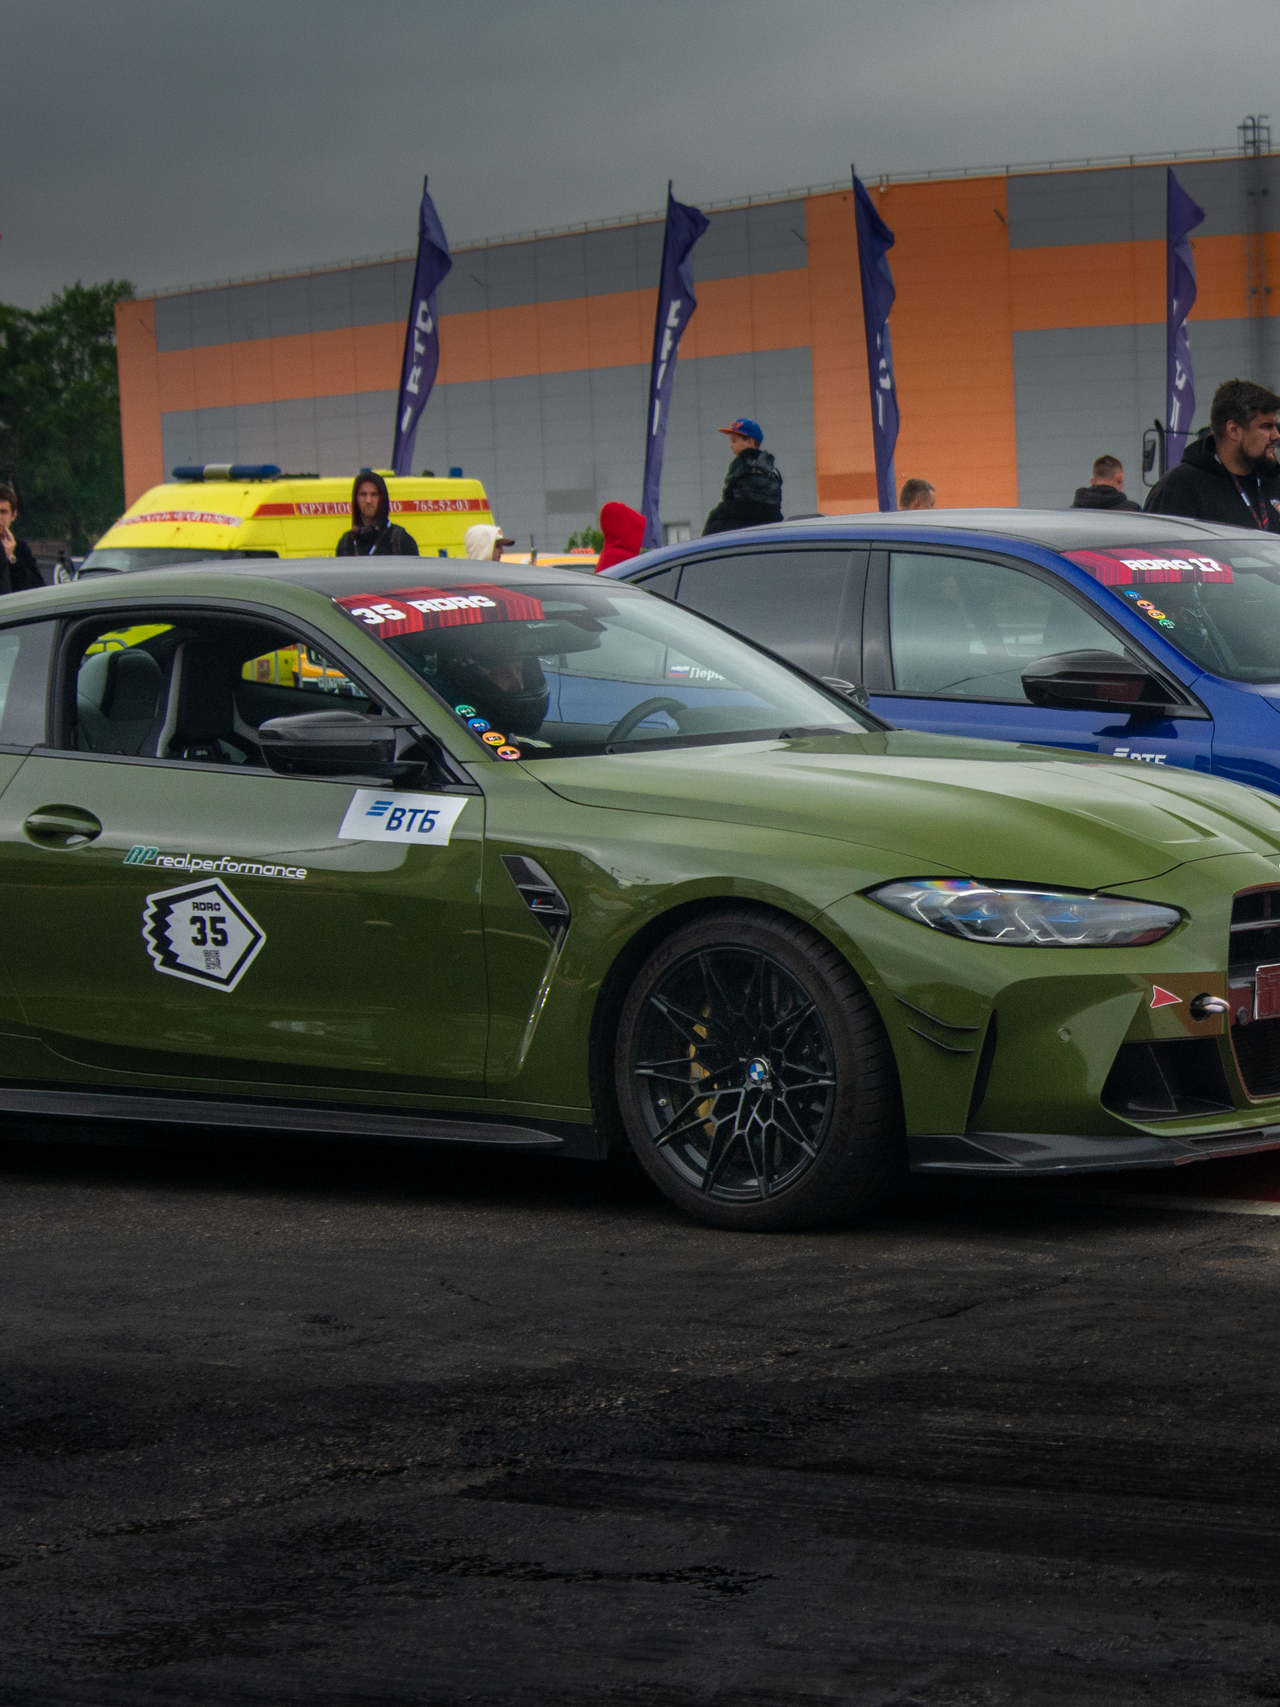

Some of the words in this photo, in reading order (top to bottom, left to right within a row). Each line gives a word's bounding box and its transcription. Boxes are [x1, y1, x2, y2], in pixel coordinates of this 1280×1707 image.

[413, 500, 470, 512] 765-52-03
[1119, 559, 1194, 570] RDRC
[1187, 557, 1223, 572] 17
[351, 603, 407, 625] 35
[405, 595, 497, 613] RDRC
[385, 807, 440, 833] ВТБ
[155, 853, 307, 881] real.performance
[191, 902, 222, 912] RDRC
[189, 915, 229, 947] 35
